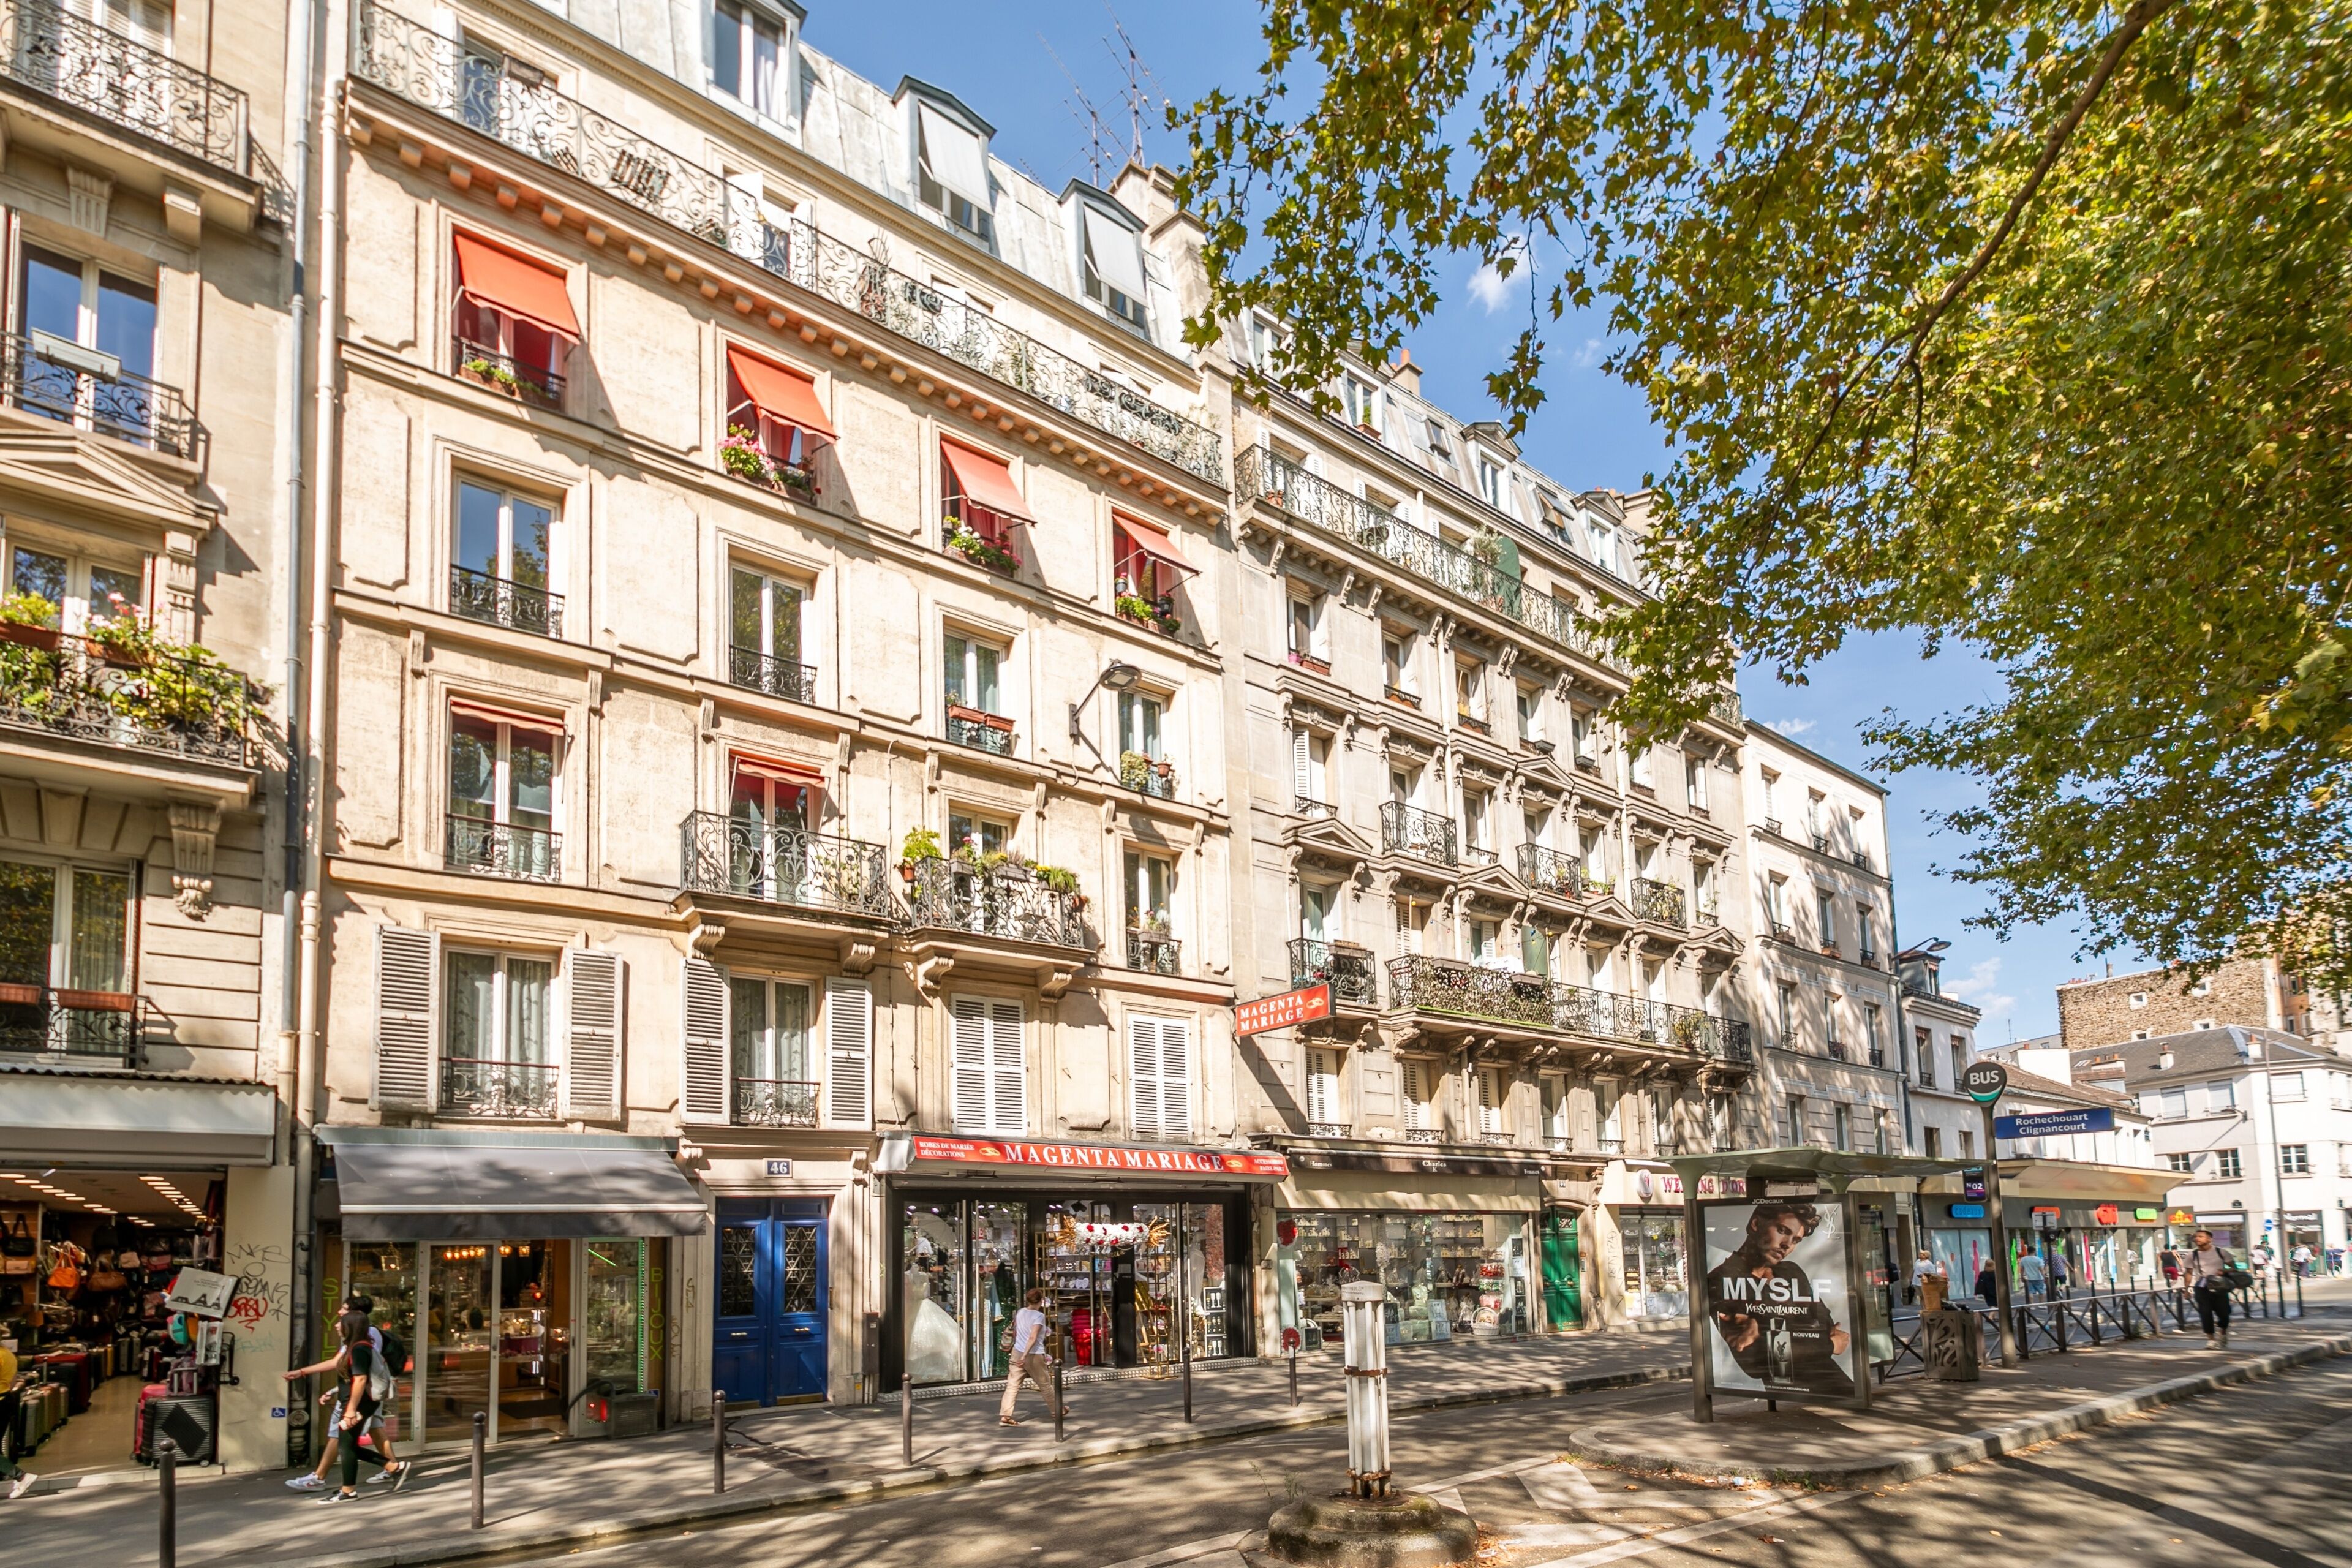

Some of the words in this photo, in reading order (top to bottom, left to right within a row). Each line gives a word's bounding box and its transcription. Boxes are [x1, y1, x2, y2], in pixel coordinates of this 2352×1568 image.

[1240, 995, 1303, 1019] MAGENTA
[1240, 1008, 1303, 1031] MARIAGE
[1969, 1071, 1999, 1085] BUS
[2015, 1113, 2089, 1126] Rochechouart
[2019, 1123, 2086, 1135] Clignancourt
[921, 1148, 966, 1158] DÉCORATIONS
[1003, 1144, 1120, 1166] MAGENTA
[1123, 1151, 1224, 1171] MARIAGE
[770, 1161, 788, 1174] 46
[1722, 1276, 1832, 1302] MYSLF
[649, 1267, 665, 1360] BIJOUX
